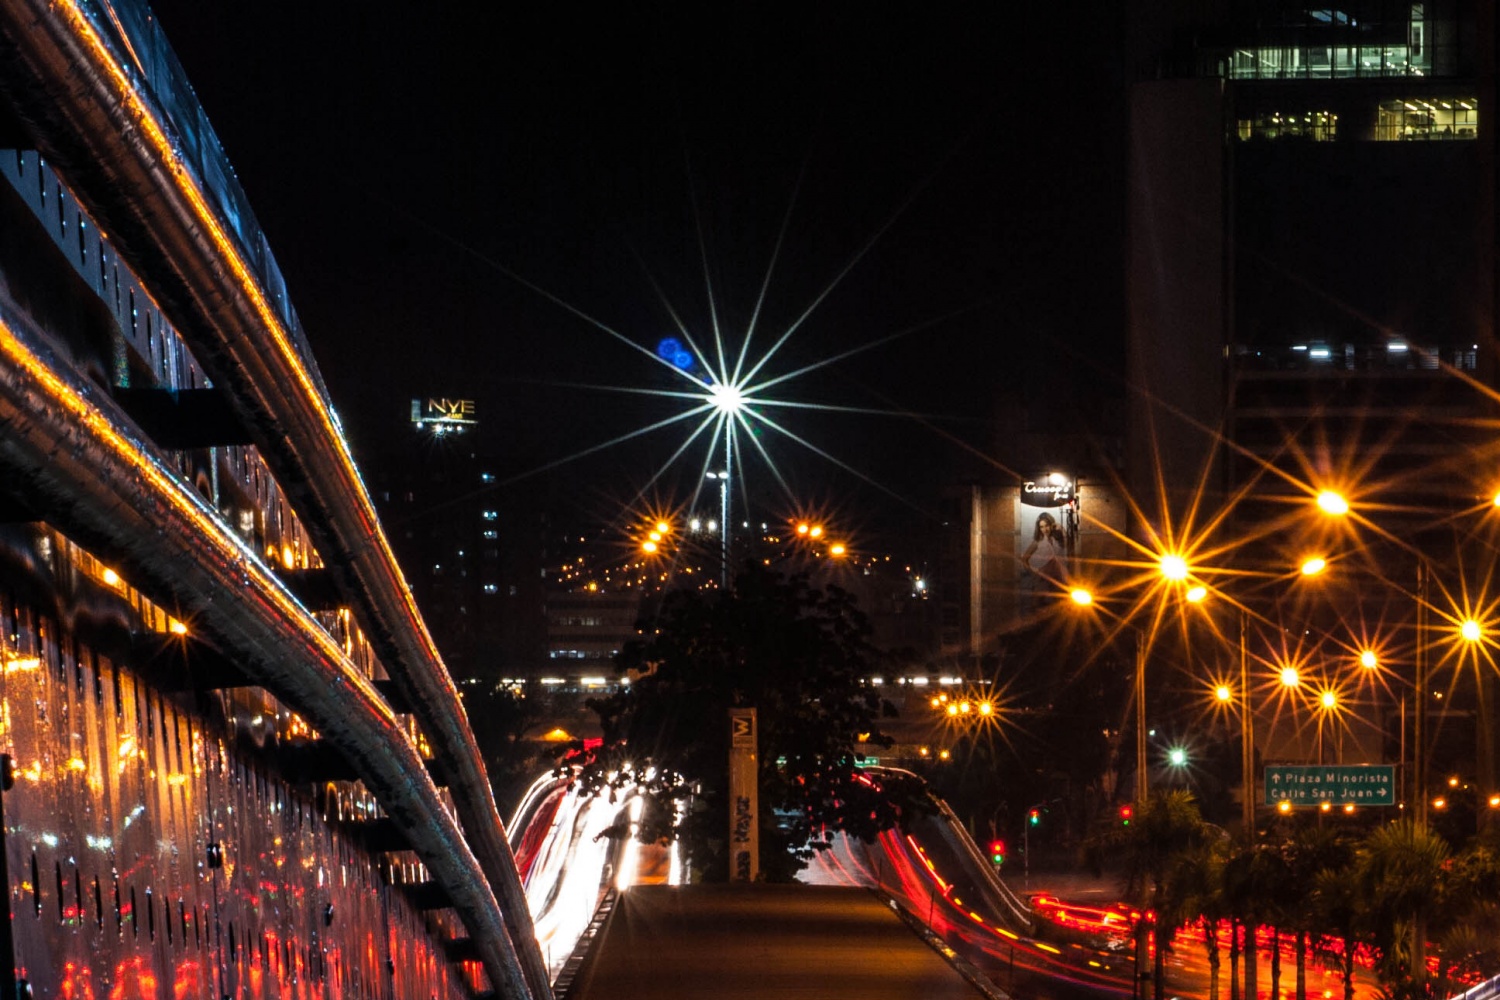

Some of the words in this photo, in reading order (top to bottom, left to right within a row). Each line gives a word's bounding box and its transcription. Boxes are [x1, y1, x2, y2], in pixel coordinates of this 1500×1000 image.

[1286, 773, 1321, 783] Plaza
[1326, 773, 1389, 783] Minorista
[1271, 788, 1306, 798] Calle
[1312, 788, 1335, 798] San
[1341, 788, 1373, 798] Juan
